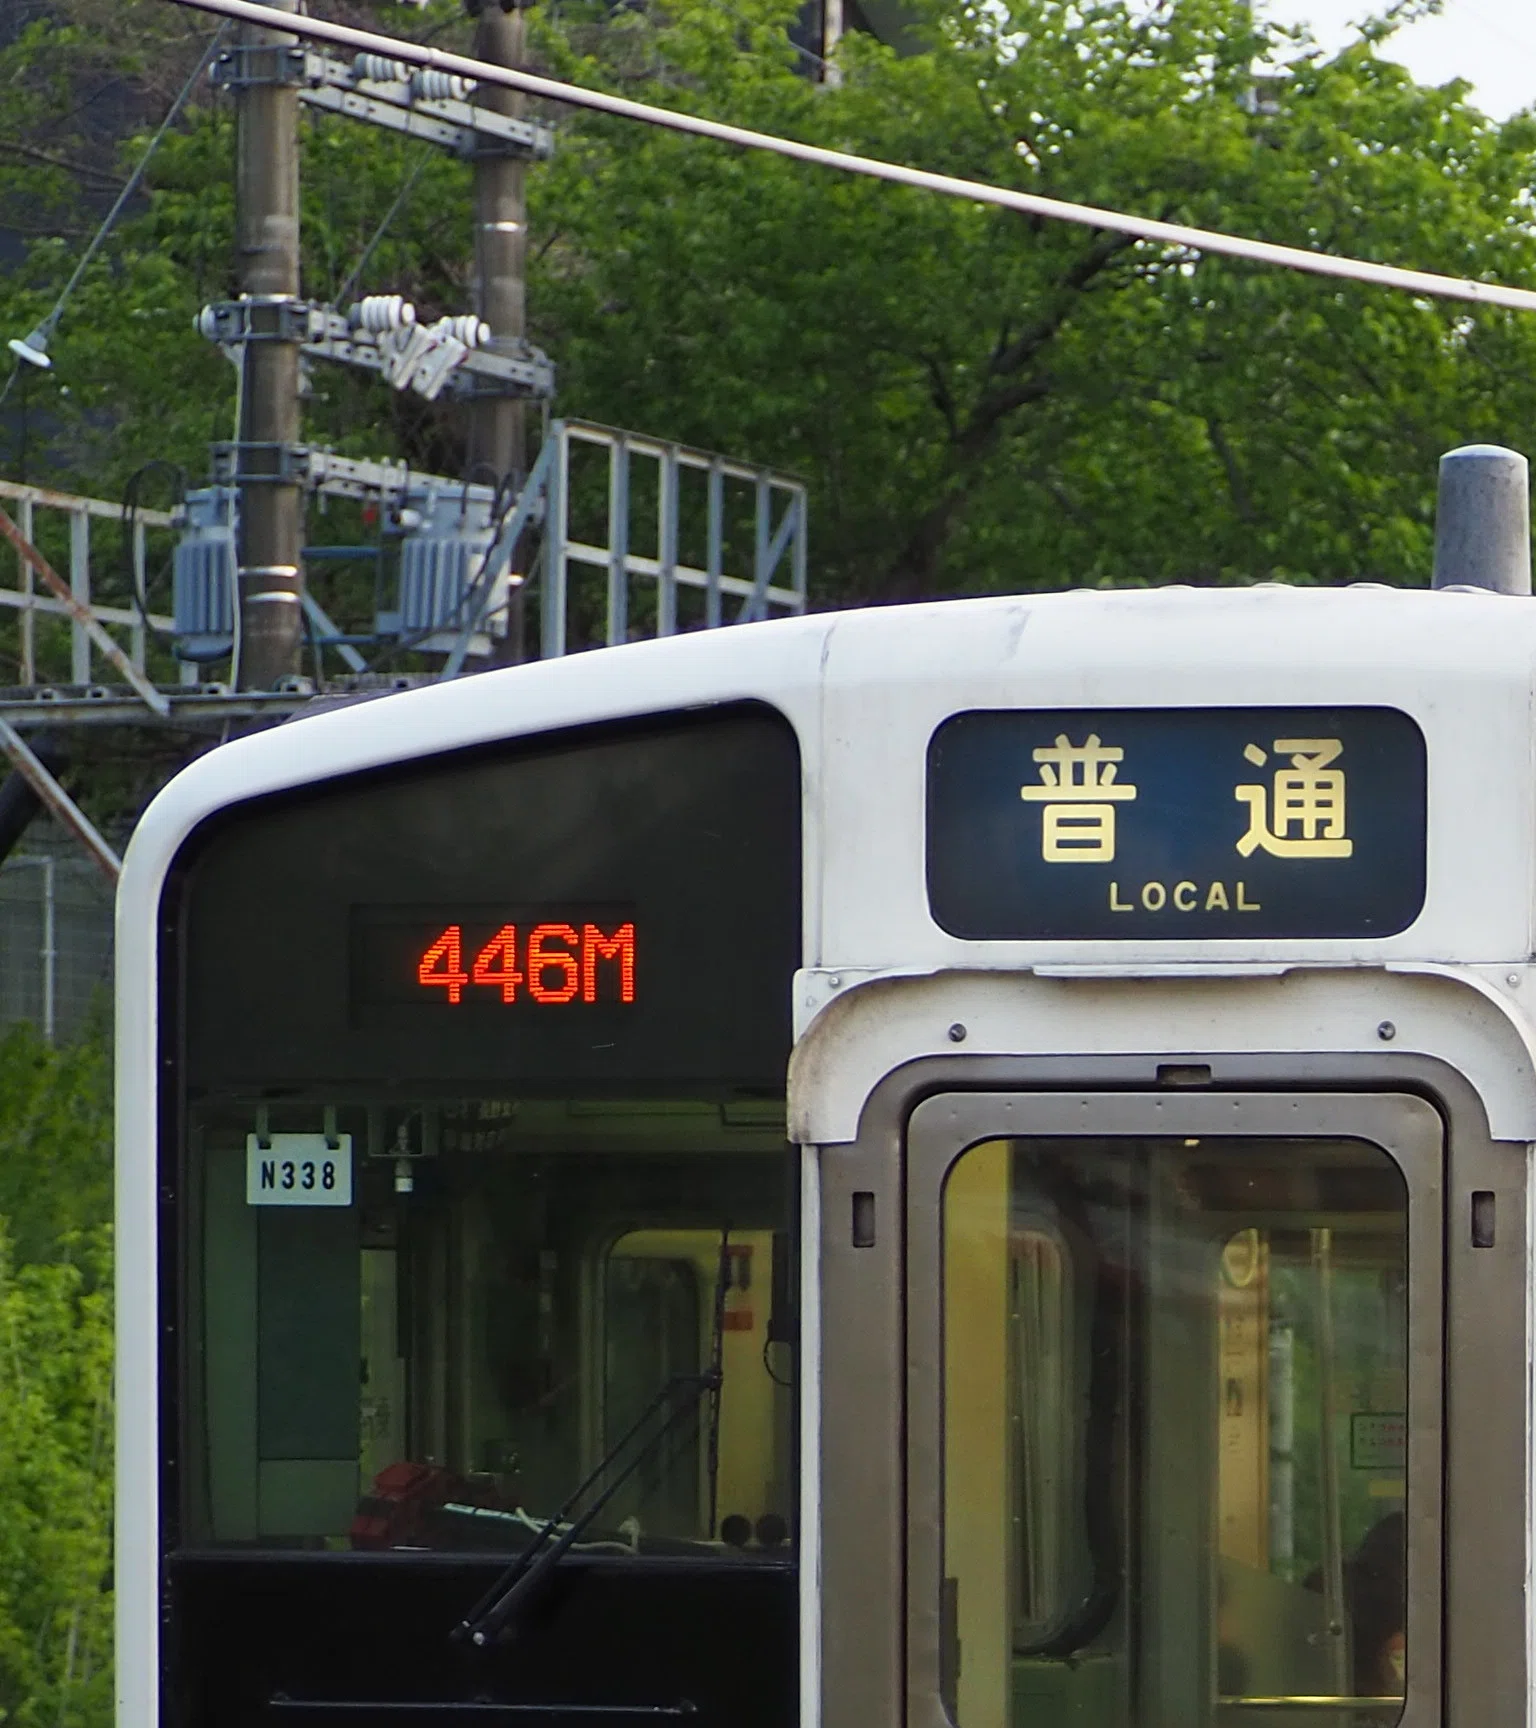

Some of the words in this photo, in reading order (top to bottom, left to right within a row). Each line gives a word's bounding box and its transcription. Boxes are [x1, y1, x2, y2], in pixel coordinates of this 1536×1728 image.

[1021, 733, 1352, 866] 普通
[1109, 881, 1261, 914] LOCAL
[417, 922, 637, 1005] 446M
[260, 1159, 337, 1192] N338
